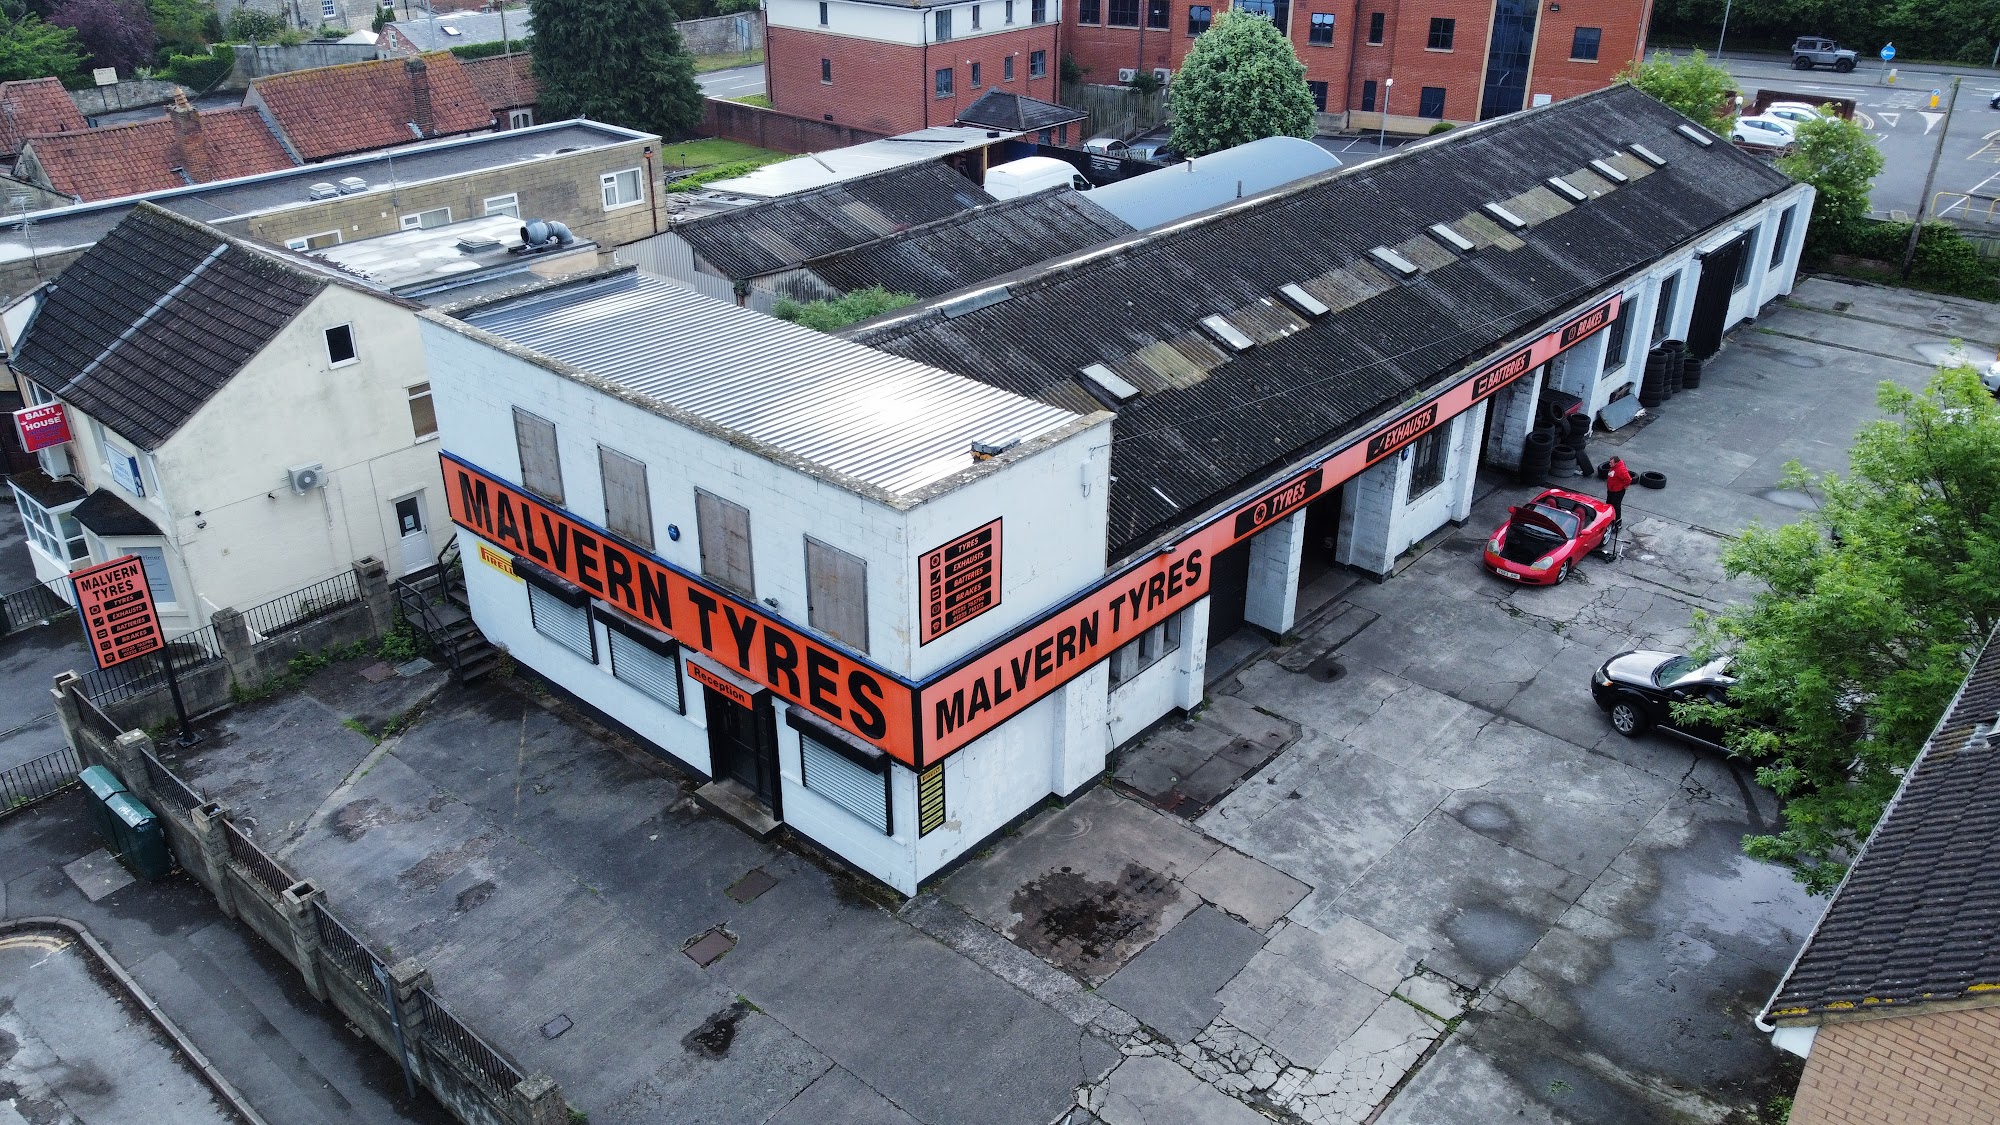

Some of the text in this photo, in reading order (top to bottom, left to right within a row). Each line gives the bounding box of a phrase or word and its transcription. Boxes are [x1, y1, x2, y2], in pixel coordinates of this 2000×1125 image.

[1577, 310, 1604, 337] BRAKES
[1487, 354, 1527, 391] BATTERIES
[24, 407, 55, 420] BALTI
[25, 416, 61, 431] HOUSE
[1383, 409, 1432, 450] EXHAUSTS
[1271, 481, 1307, 515] TYRES
[958, 537, 979, 553] TYRES
[953, 550, 984, 572] EXHAUSTS
[80, 564, 138, 592] MALVERN
[953, 566, 984, 587] BATTERIES
[92, 579, 134, 601] TYRES
[114, 595, 134, 606] TYRES
[955, 582, 982, 602] BRAKES
[112, 605, 143, 620] EXHAUSTS
[458, 470, 886, 740] MALVERN TYRES
[116, 617, 146, 632] BATTERIES
[121, 629, 148, 643] BRAKES
[935, 549, 1202, 741] MALVERN TYRES
[693, 666, 746, 702] Reception
